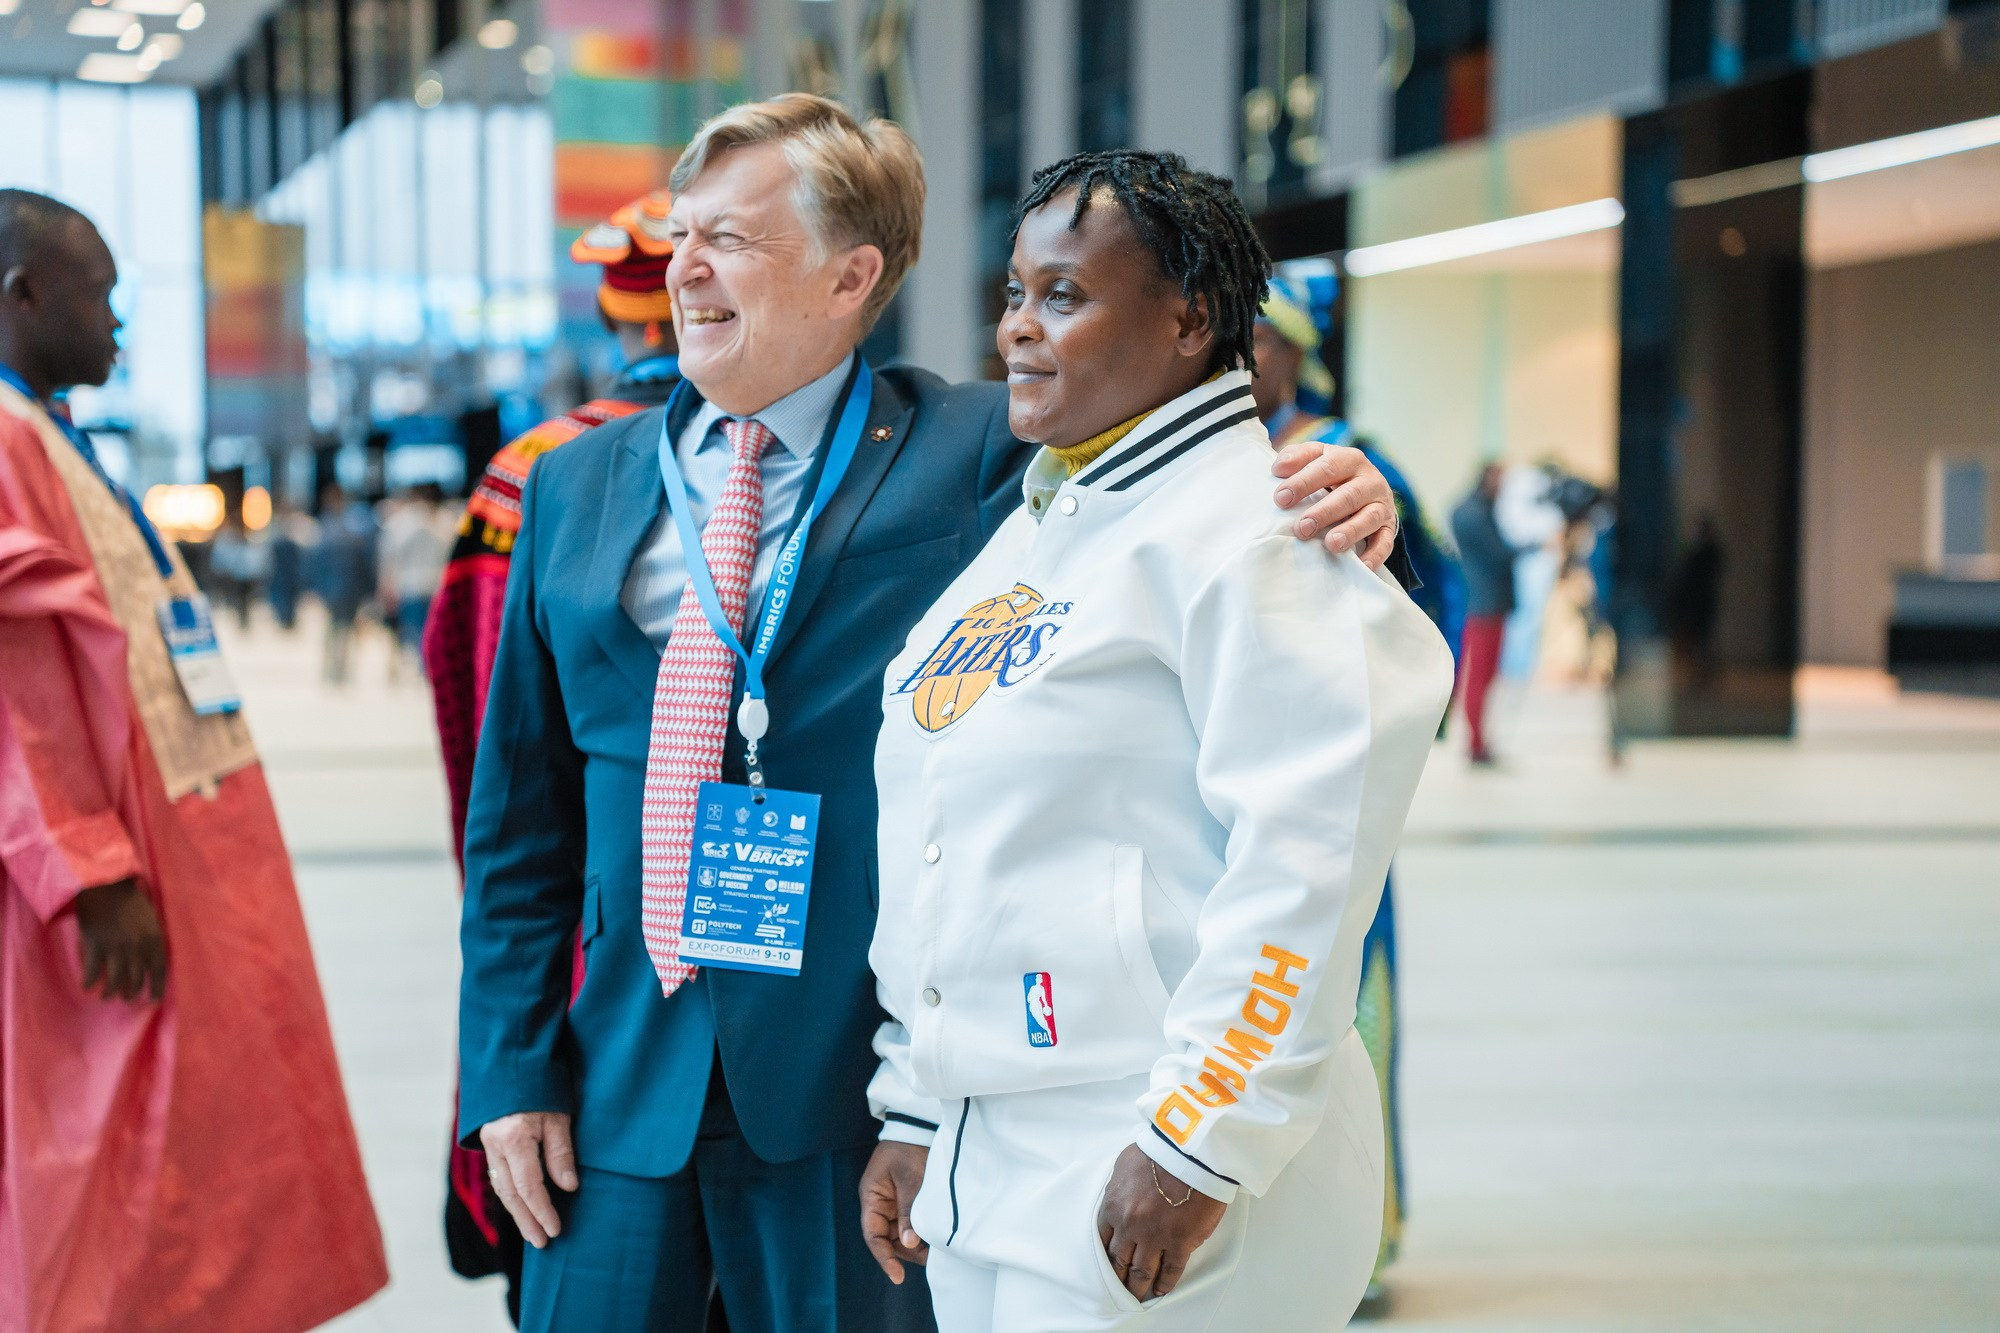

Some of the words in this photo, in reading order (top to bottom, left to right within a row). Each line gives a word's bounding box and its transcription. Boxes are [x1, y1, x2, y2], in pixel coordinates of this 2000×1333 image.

[757, 588, 787, 655] IMBRICS
[748, 849, 804, 867] BRICS+
[698, 900, 717, 910] NCA
[708, 920, 742, 930] POLYTECH
[688, 941, 760, 956] EXPOFORUM
[1031, 1032, 1050, 1044] NBA
